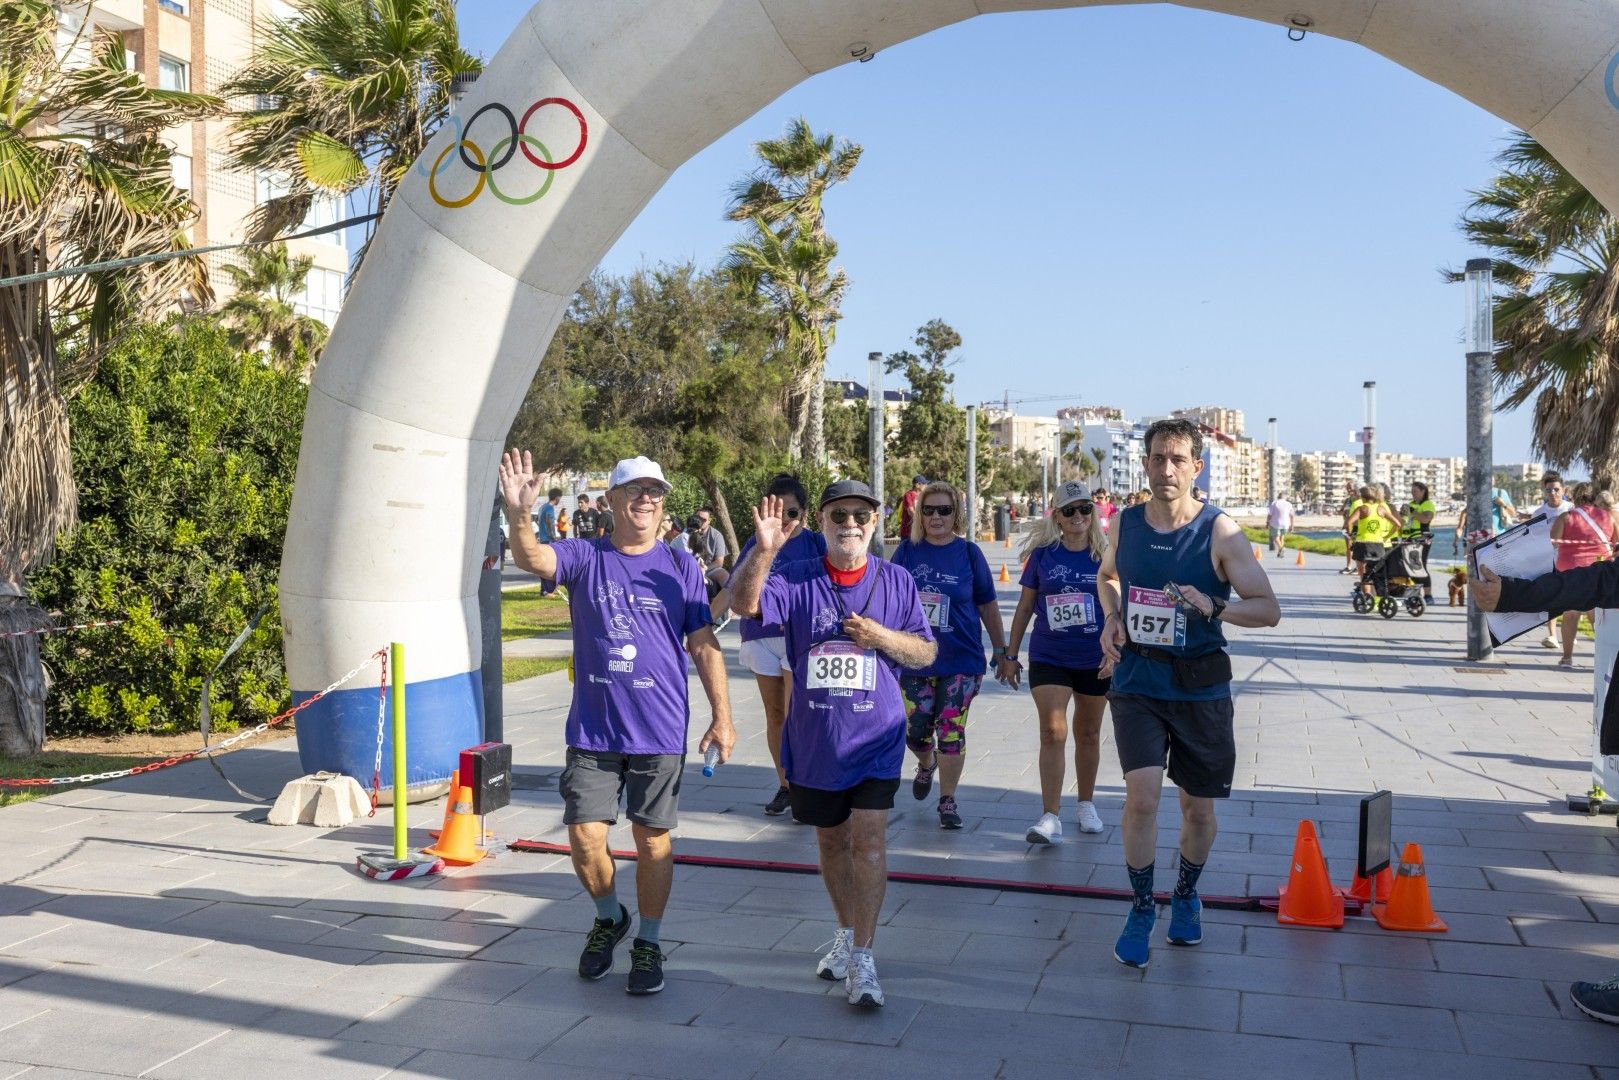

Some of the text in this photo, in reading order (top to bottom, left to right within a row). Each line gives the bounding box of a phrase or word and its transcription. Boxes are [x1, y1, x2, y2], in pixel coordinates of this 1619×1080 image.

[1052, 603, 1082, 623] 354
[1176, 612, 1185, 629] KM
[1130, 613, 1171, 634] 157
[816, 656, 858, 680] 388
